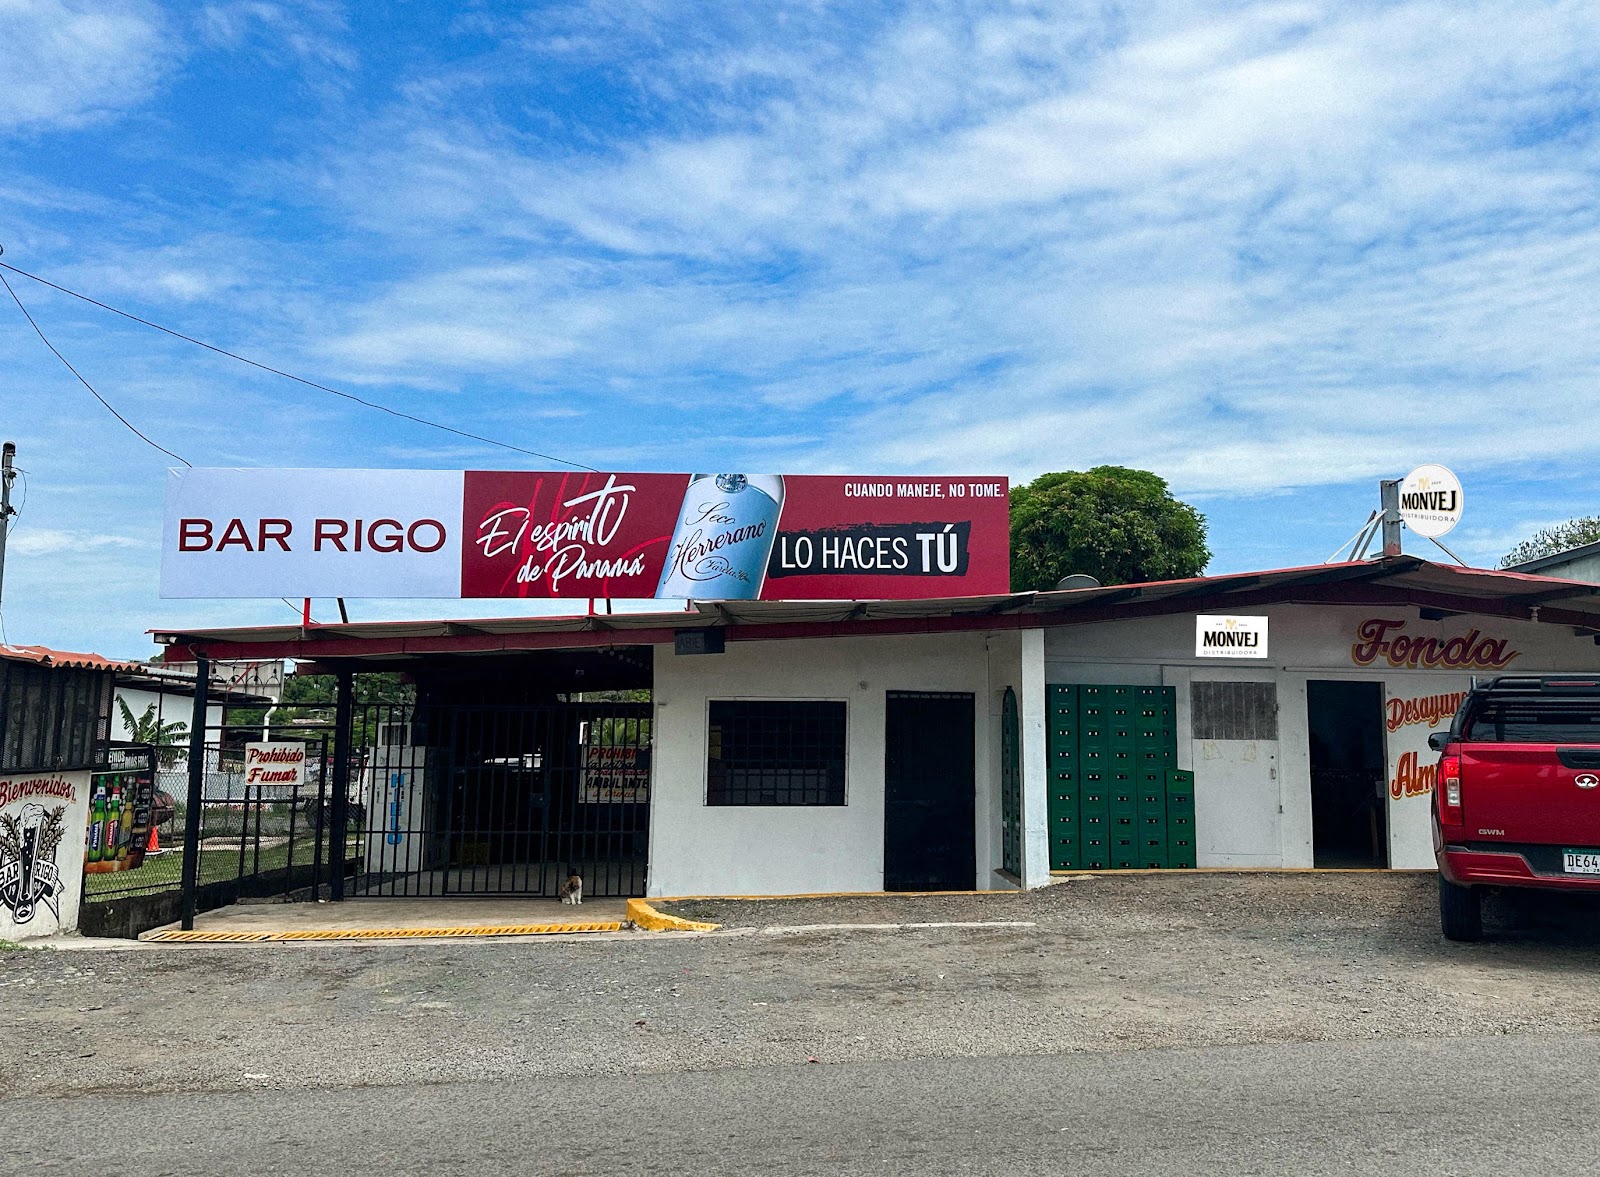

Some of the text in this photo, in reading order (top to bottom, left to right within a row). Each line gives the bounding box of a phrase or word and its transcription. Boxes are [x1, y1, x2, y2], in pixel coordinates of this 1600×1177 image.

[844, 483, 1005, 500] CUANDO MANEJE, NO TOME.
[1401, 490, 1457, 511] MONVEJ
[685, 502, 736, 525] Seco
[1401, 513, 1456, 522] DISTRIBUIDORA
[178, 518, 447, 553] BAR RIGO
[476, 507, 531, 557] El
[663, 518, 767, 581] Herrerano
[781, 524, 959, 573] LO HACES TÚ
[516, 544, 645, 592] de Panamá
[1203, 631, 1258, 647] MONVEJ
[1352, 618, 1522, 669] Fonda
[247, 747, 304, 764] Prohibido
[589, 750, 637, 761] PROHIBI
[246, 767, 298, 784] Fumar
[1390, 751, 1438, 800] Alm
[1478, 828, 1505, 836] GWM
[1567, 855, 1599, 868] DE64
